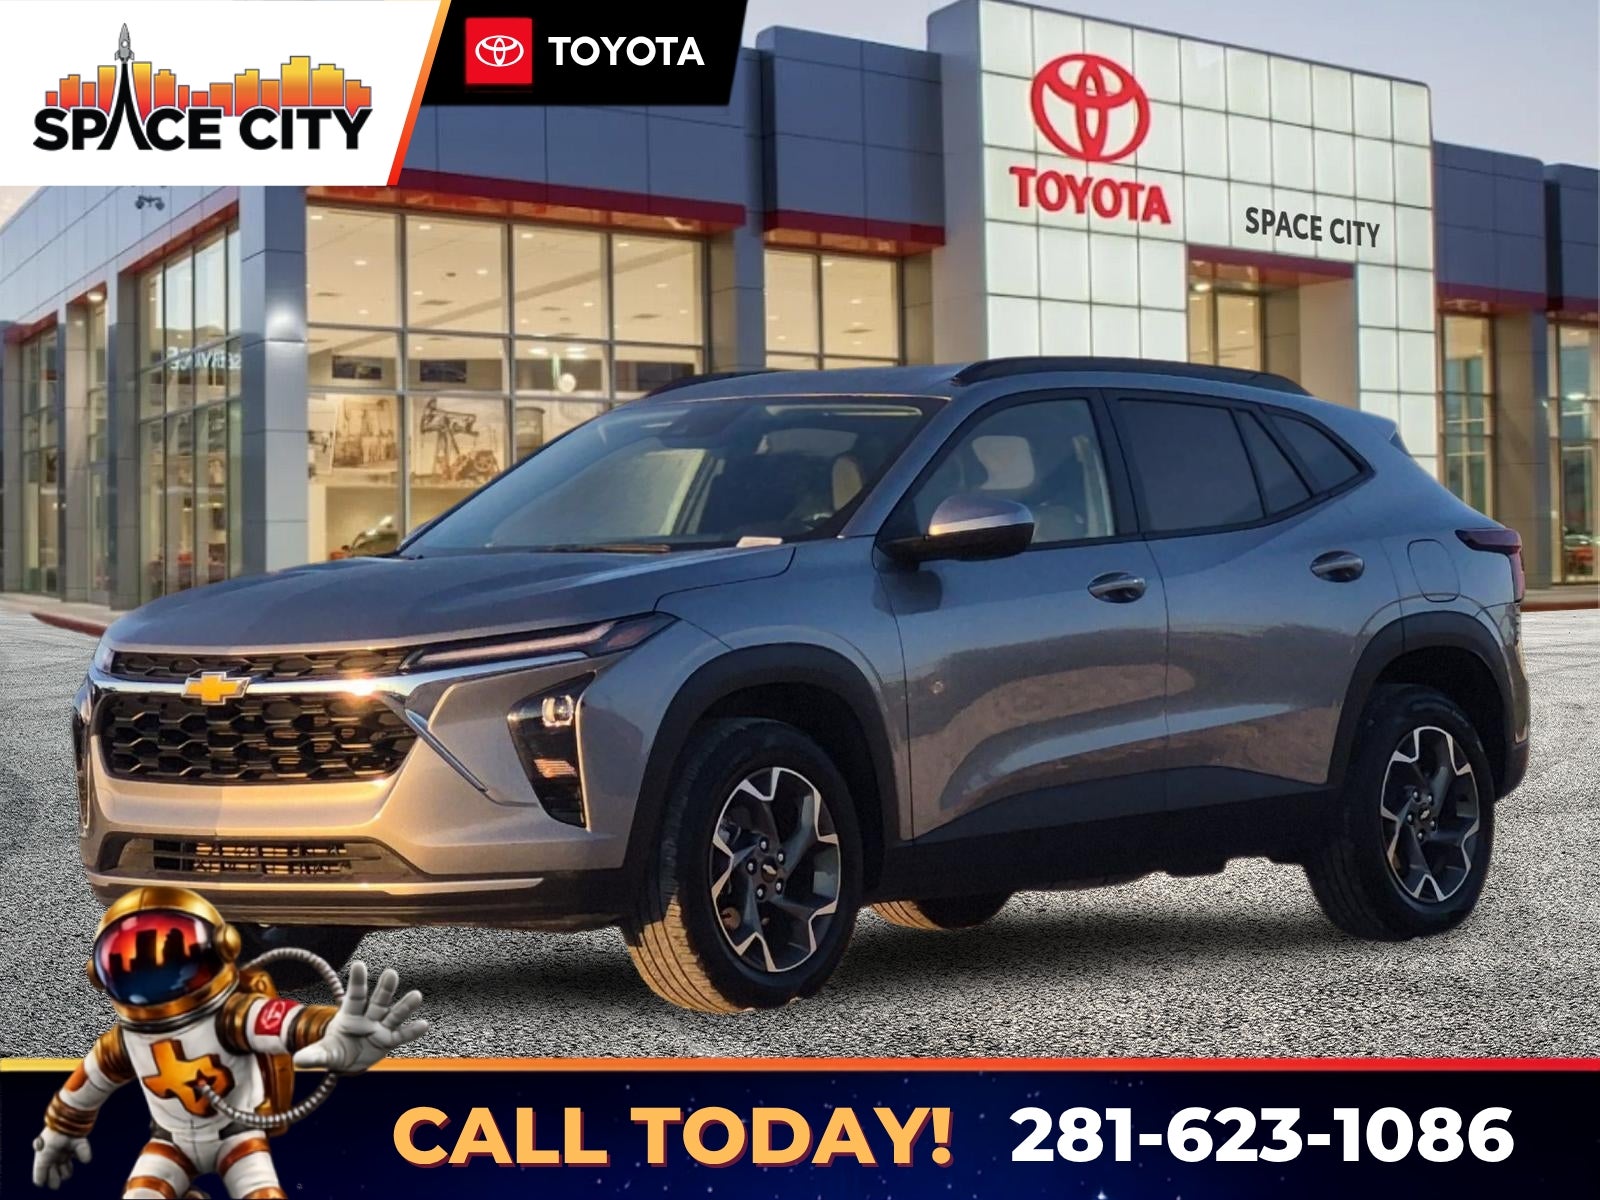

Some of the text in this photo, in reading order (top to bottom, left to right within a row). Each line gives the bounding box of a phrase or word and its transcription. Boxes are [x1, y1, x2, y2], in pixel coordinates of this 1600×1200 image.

[1009, 166, 1171, 224] TOYOTA
[1245, 206, 1381, 248] SPACE CITY
